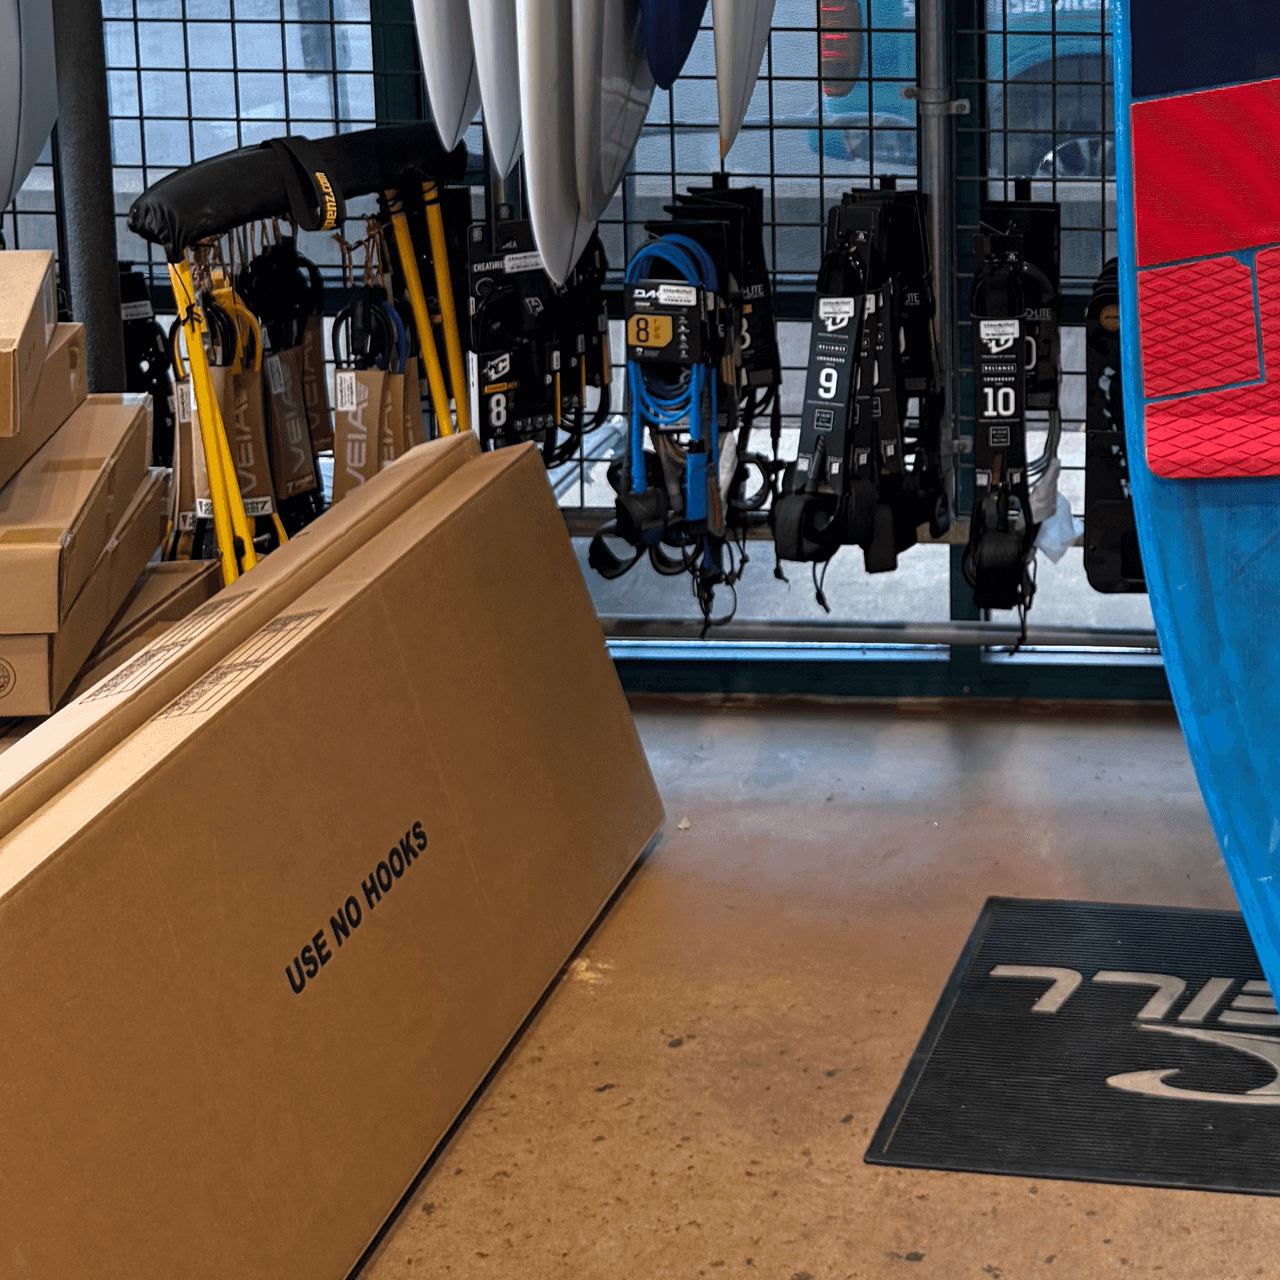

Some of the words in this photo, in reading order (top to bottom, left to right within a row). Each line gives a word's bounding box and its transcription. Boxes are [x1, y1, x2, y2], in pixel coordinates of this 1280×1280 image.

[818, 367, 838, 399] 9
[488, 393, 507, 426] 8
[983, 387, 1016, 417] 10
[285, 931, 333, 994] USE
[329, 894, 363, 948] NO
[362, 820, 429, 910] HOOKS
